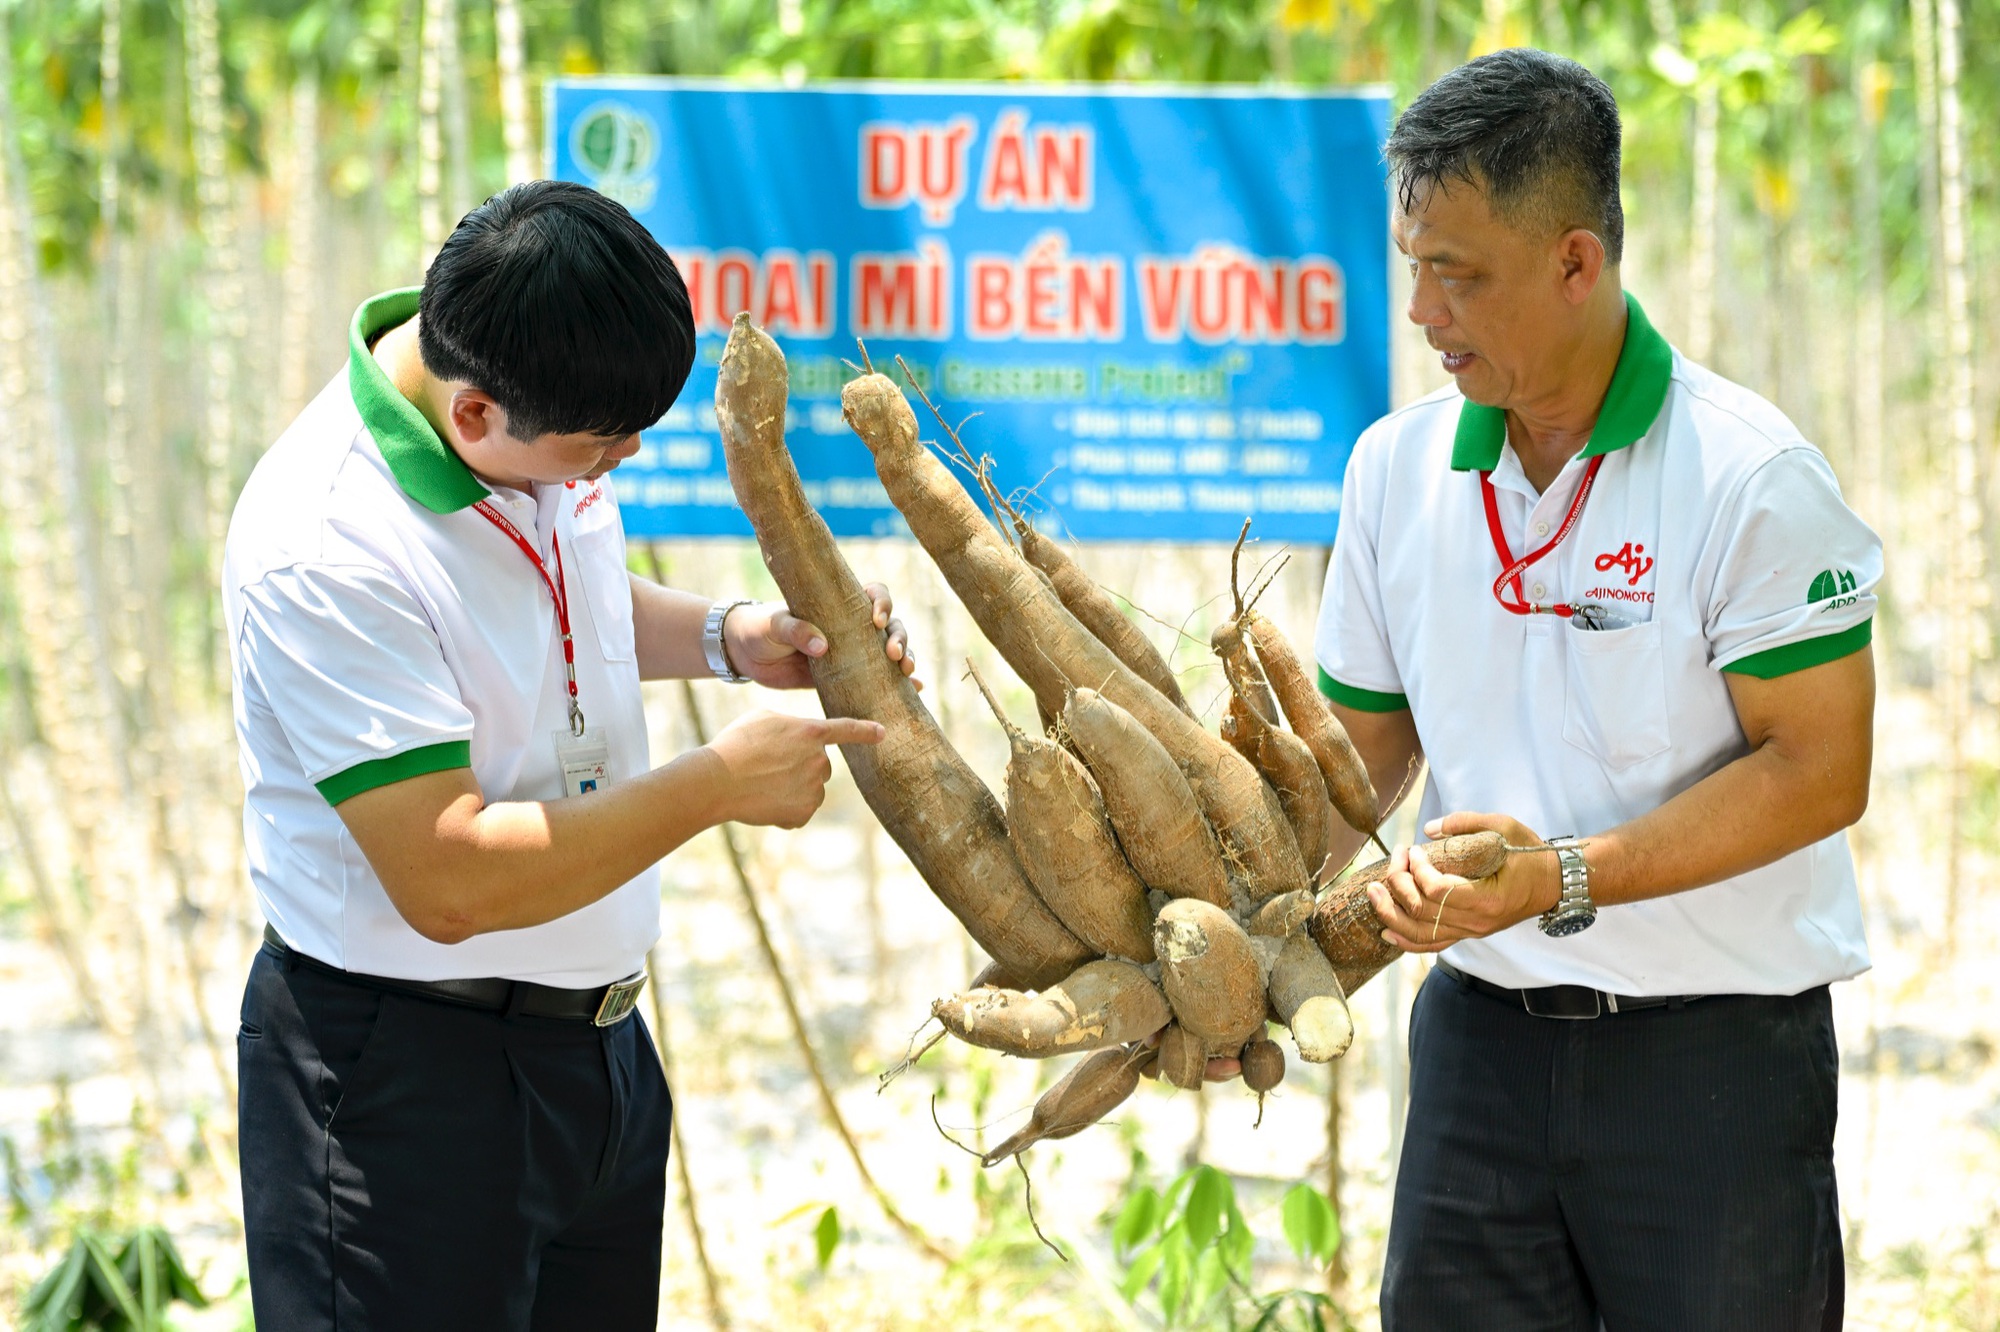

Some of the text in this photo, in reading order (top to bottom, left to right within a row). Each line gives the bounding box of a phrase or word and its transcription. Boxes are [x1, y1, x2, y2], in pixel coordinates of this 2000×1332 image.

[863, 110, 1088, 221] DỰ ÁN
[674, 253, 830, 333] HOAI
[856, 241, 950, 334] MÌ
[1138, 246, 1342, 342] VỮNG
